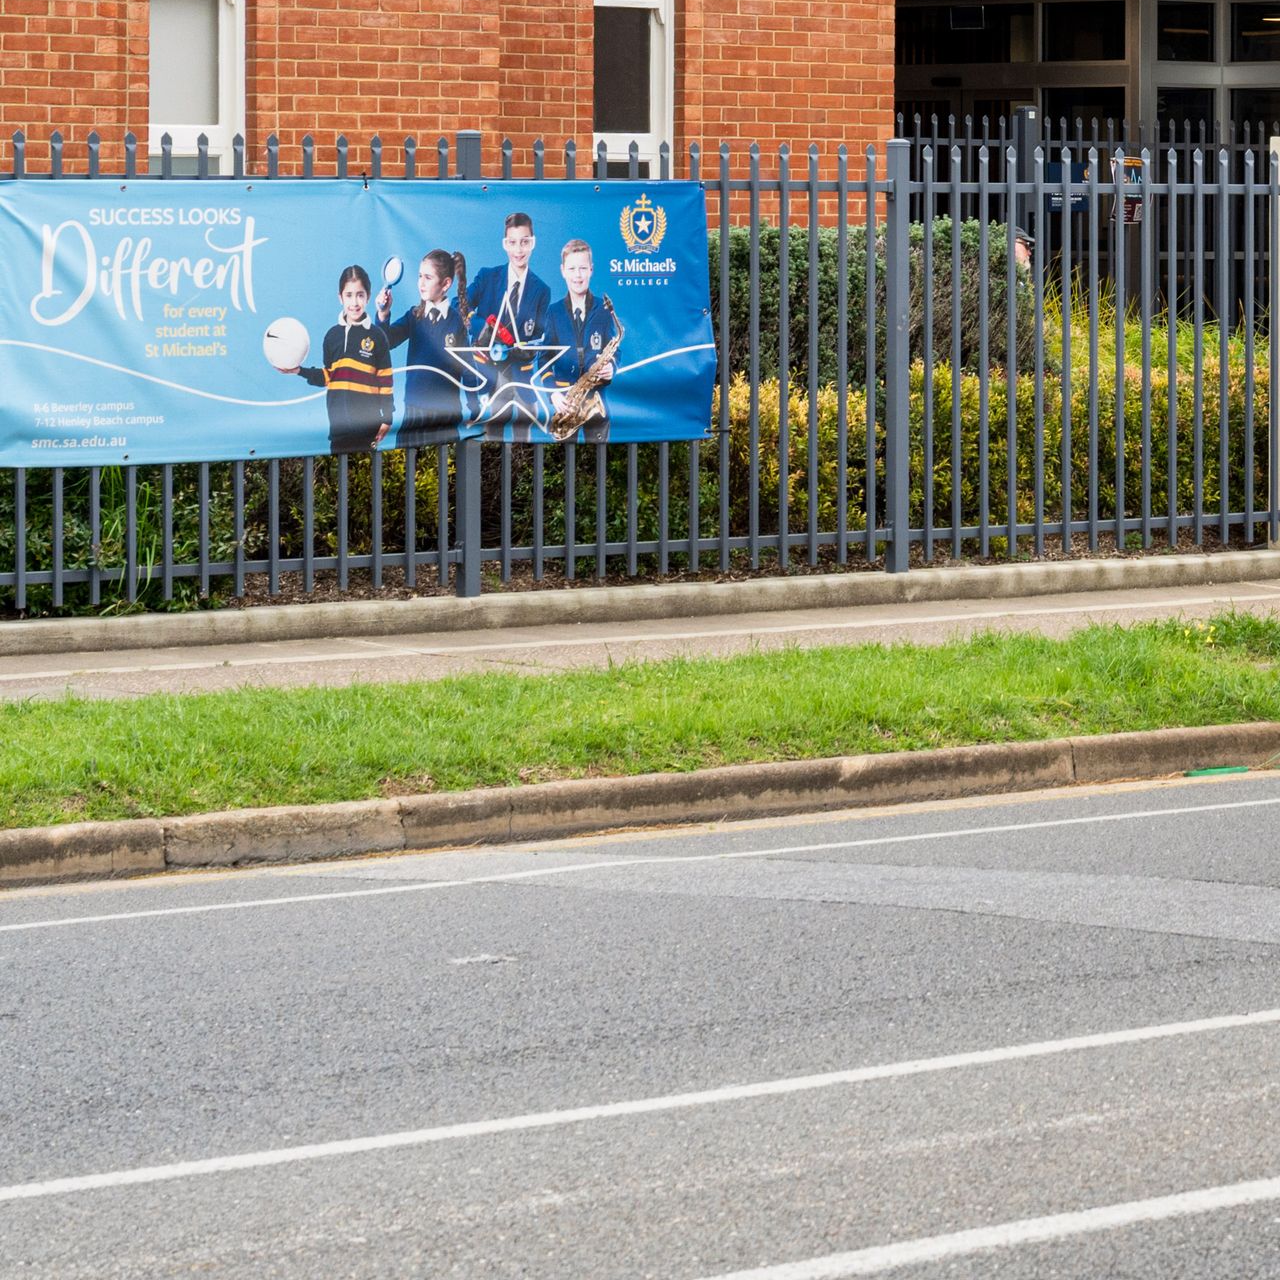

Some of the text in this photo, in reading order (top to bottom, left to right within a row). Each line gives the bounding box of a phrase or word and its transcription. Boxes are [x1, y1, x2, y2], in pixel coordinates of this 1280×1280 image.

[89, 207, 241, 225] SUCCESS LOOKS
[30, 216, 270, 326] Different
[610, 257, 677, 272] St Michael's
[617, 278, 669, 286] COLLEGE
[163, 303, 227, 321] for every
[155, 324, 226, 338] student at
[145, 343, 227, 358] St Michael's
[52, 401, 94, 414] Beverley
[95, 401, 135, 413] campus
[35, 414, 165, 428] 7-12 Henley Beach campus
[31, 435, 127, 449] smc.sa.edu.au
